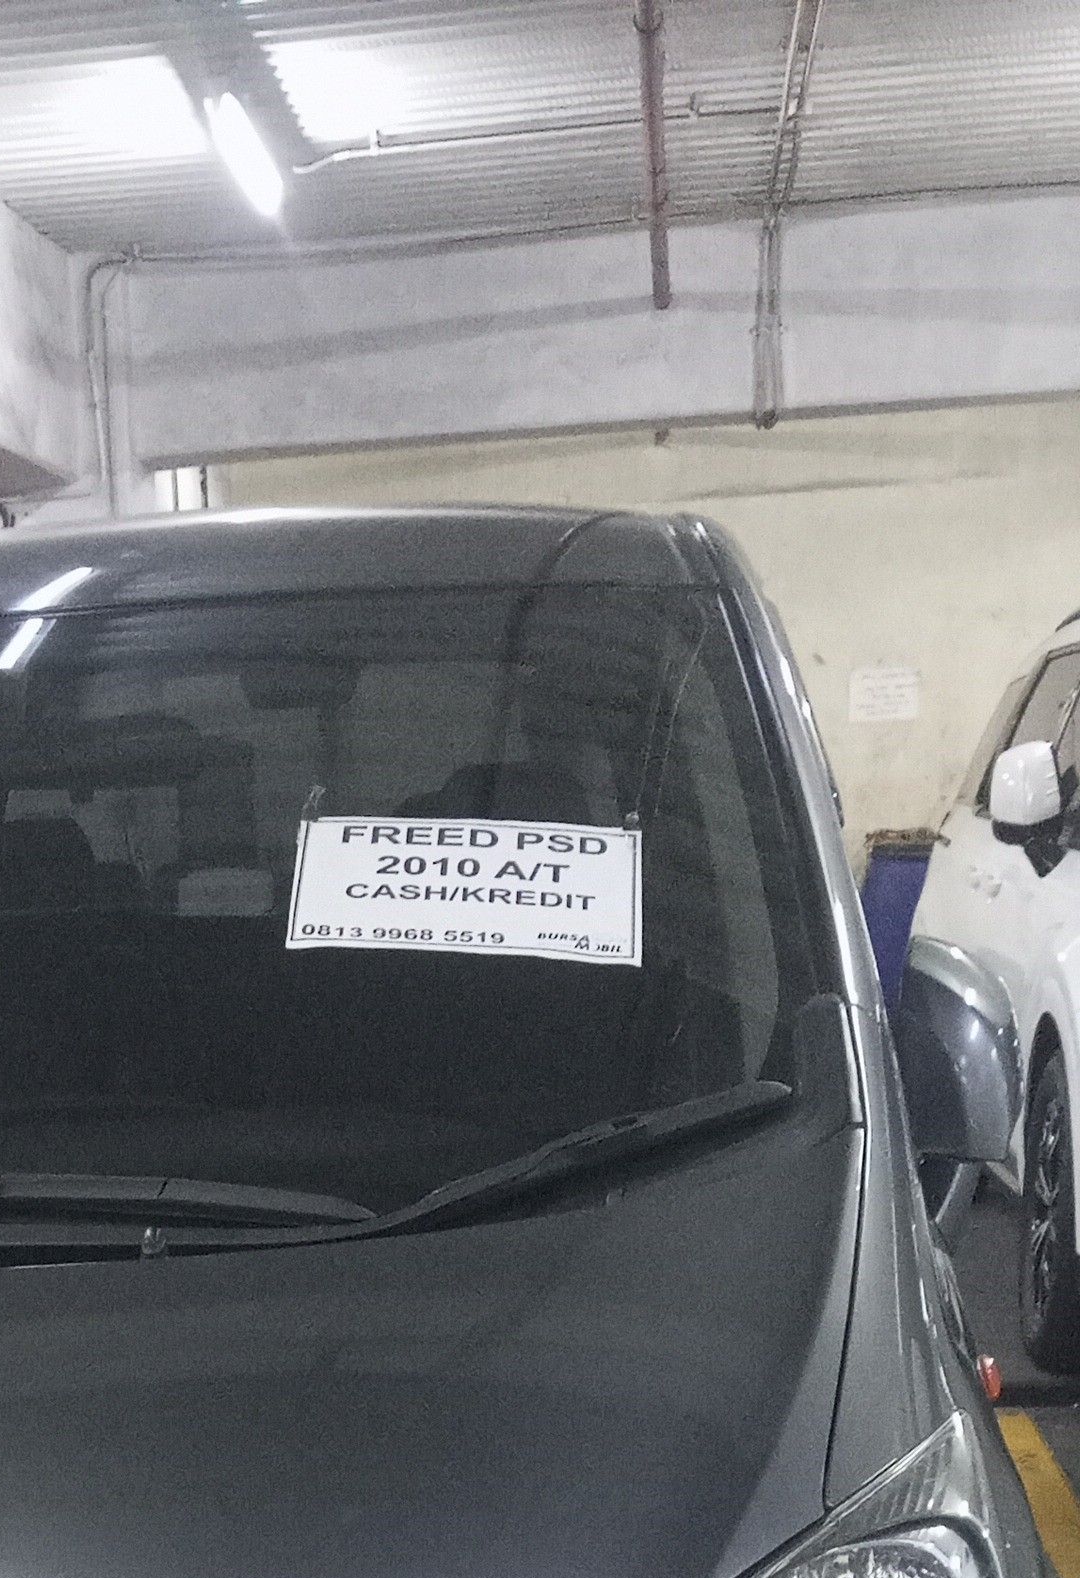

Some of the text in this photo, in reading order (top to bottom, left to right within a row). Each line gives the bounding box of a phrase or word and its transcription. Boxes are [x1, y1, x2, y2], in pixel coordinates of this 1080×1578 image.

[341, 825, 608, 855] FREED PSD
[375, 854, 570, 883] 2010 A/T
[345, 883, 596, 911] CASH/KREDIT
[301, 923, 505, 944] 0813 9968 5519
